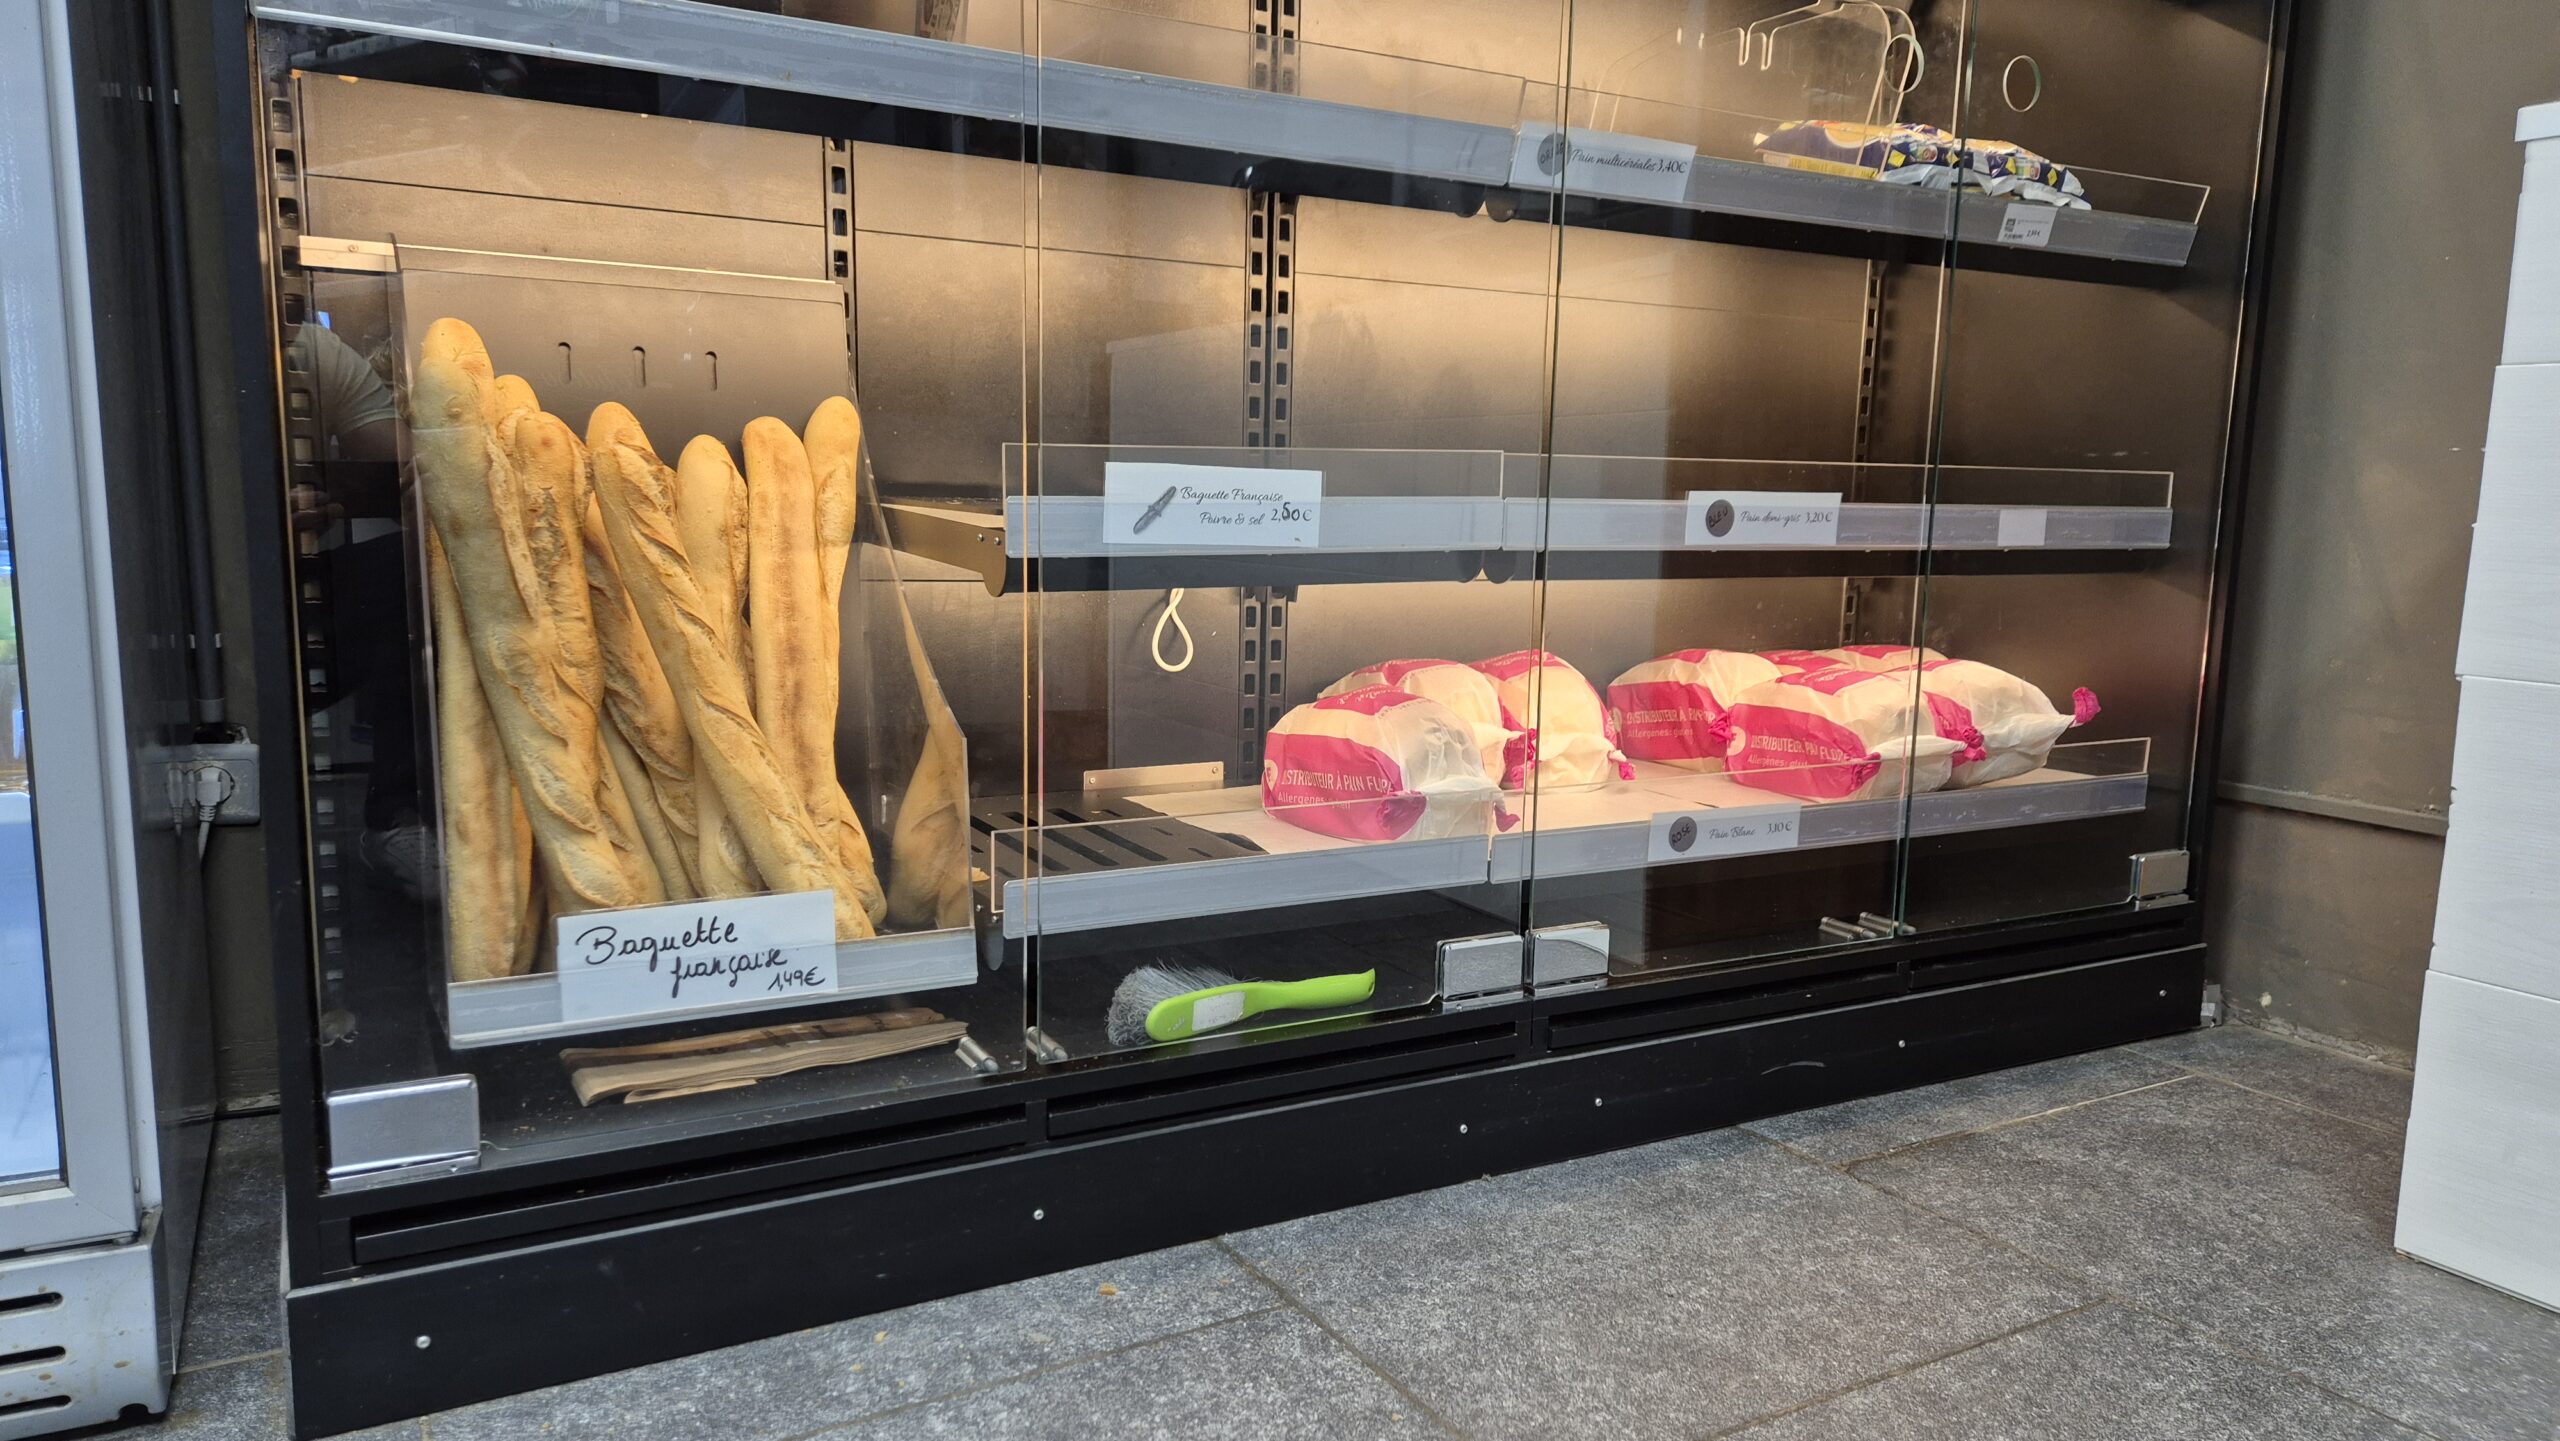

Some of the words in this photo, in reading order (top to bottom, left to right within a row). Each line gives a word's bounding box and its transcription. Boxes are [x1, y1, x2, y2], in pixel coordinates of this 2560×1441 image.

[1572, 149, 1595, 162] Pain
[1596, 154, 1657, 171] multicéréales
[1180, 486, 1230, 505] Baguette
[1232, 488, 1284, 505] Française
[1200, 512, 1232, 526] Poivre
[1234, 512, 1245, 525] &
[1248, 513, 1265, 526] sel
[1740, 510, 1760, 522] Pain
[1709, 828, 1729, 840] Pain
[1731, 826, 1756, 838] Blanc
[575, 916, 739, 972] Baguette
[670, 947, 788, 999] française
[767, 966, 826, 992] 1,49€
